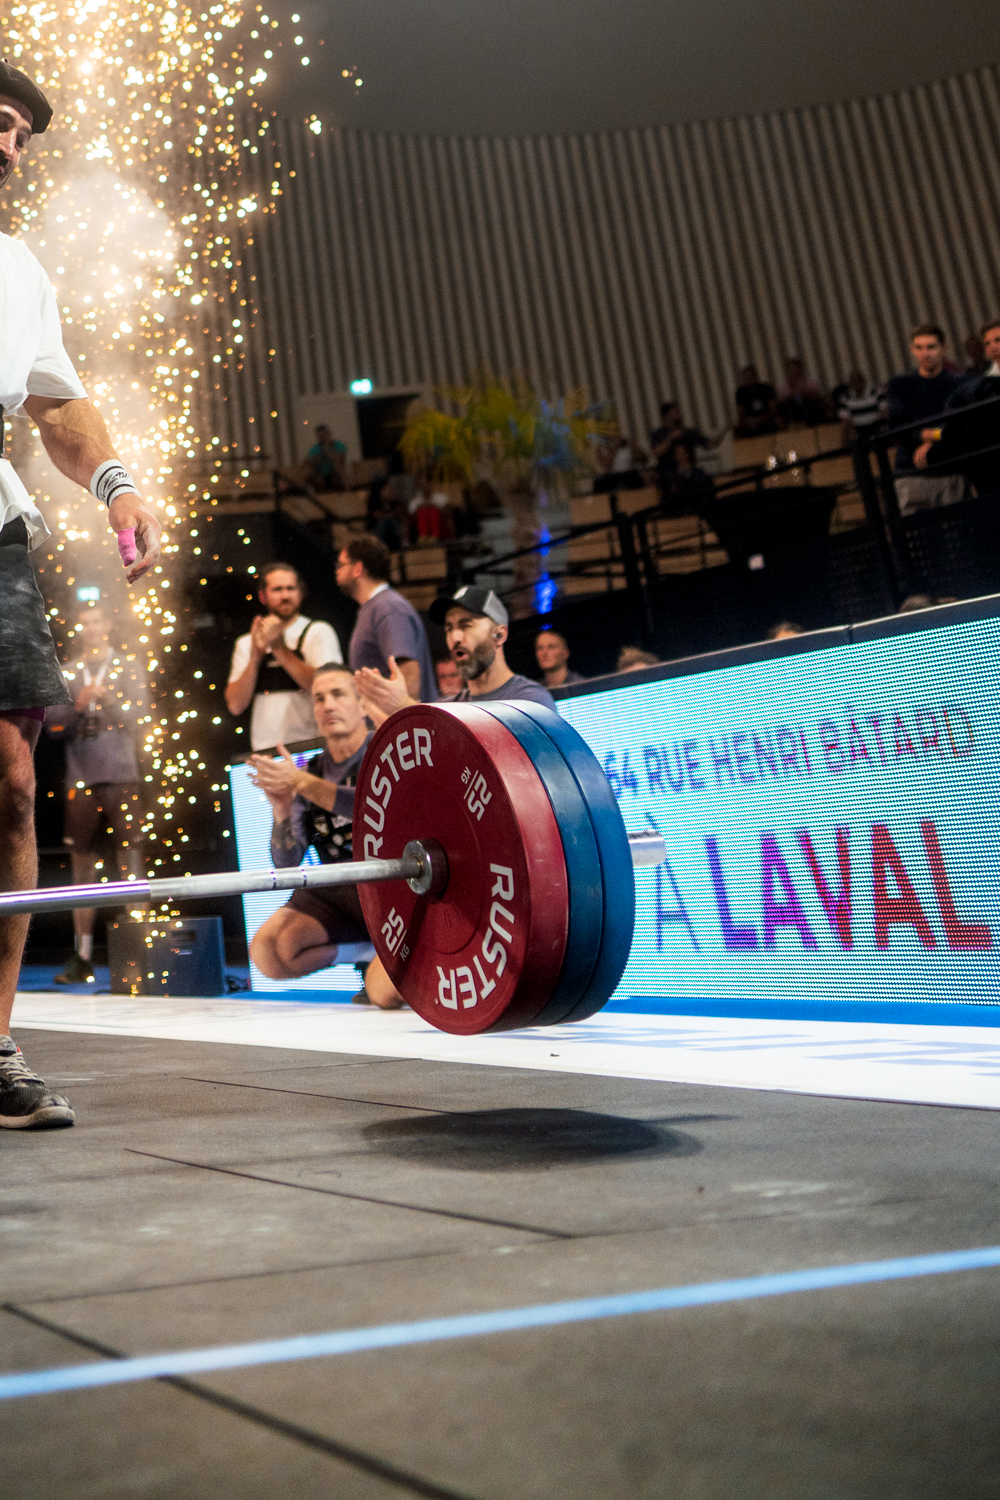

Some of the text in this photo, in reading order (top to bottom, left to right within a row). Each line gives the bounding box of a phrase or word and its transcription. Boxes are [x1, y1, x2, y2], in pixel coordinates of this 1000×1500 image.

[363, 727, 434, 861] RUSTER
[460, 766, 471, 785] KG
[643, 739, 706, 796] RUE
[708, 725, 813, 788] HENRI
[467, 773, 492, 821] 25
[645, 812, 993, 953] À LAVAL
[381, 907, 405, 953] 25
[436, 863, 515, 1011] RUSTER
